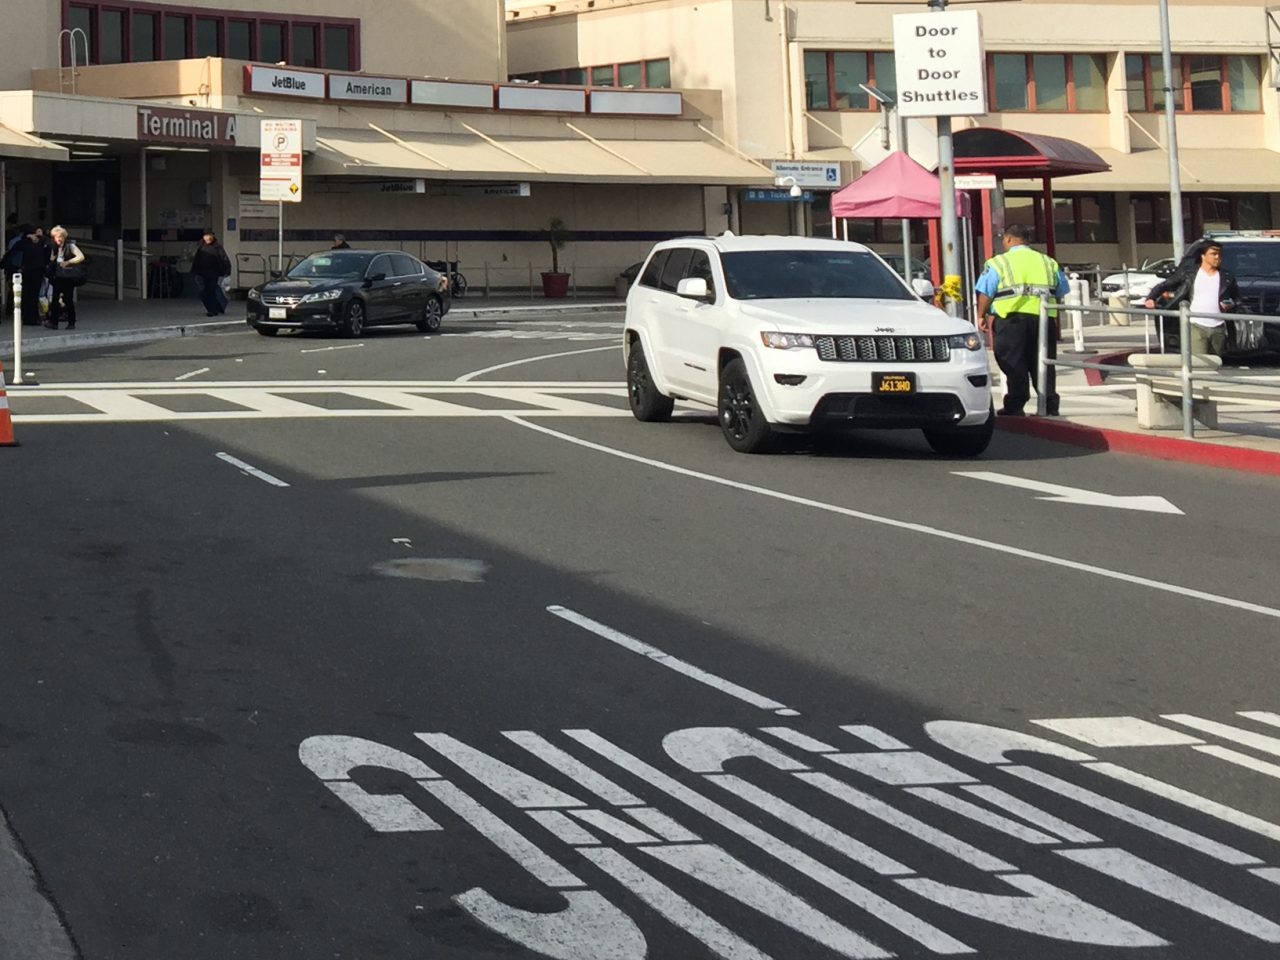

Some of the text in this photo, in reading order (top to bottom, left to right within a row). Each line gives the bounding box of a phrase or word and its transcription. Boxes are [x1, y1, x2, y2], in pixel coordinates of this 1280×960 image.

[915, 25, 958, 37] Door
[928, 47, 947, 58] to
[918, 68, 961, 80] Door
[272, 75, 306, 90] JetBlue
[346, 82, 392, 96] American
[902, 89, 979, 103] Shuttles
[139, 108, 237, 140] Terminal A
[381, 183, 414, 192] JetBlue
